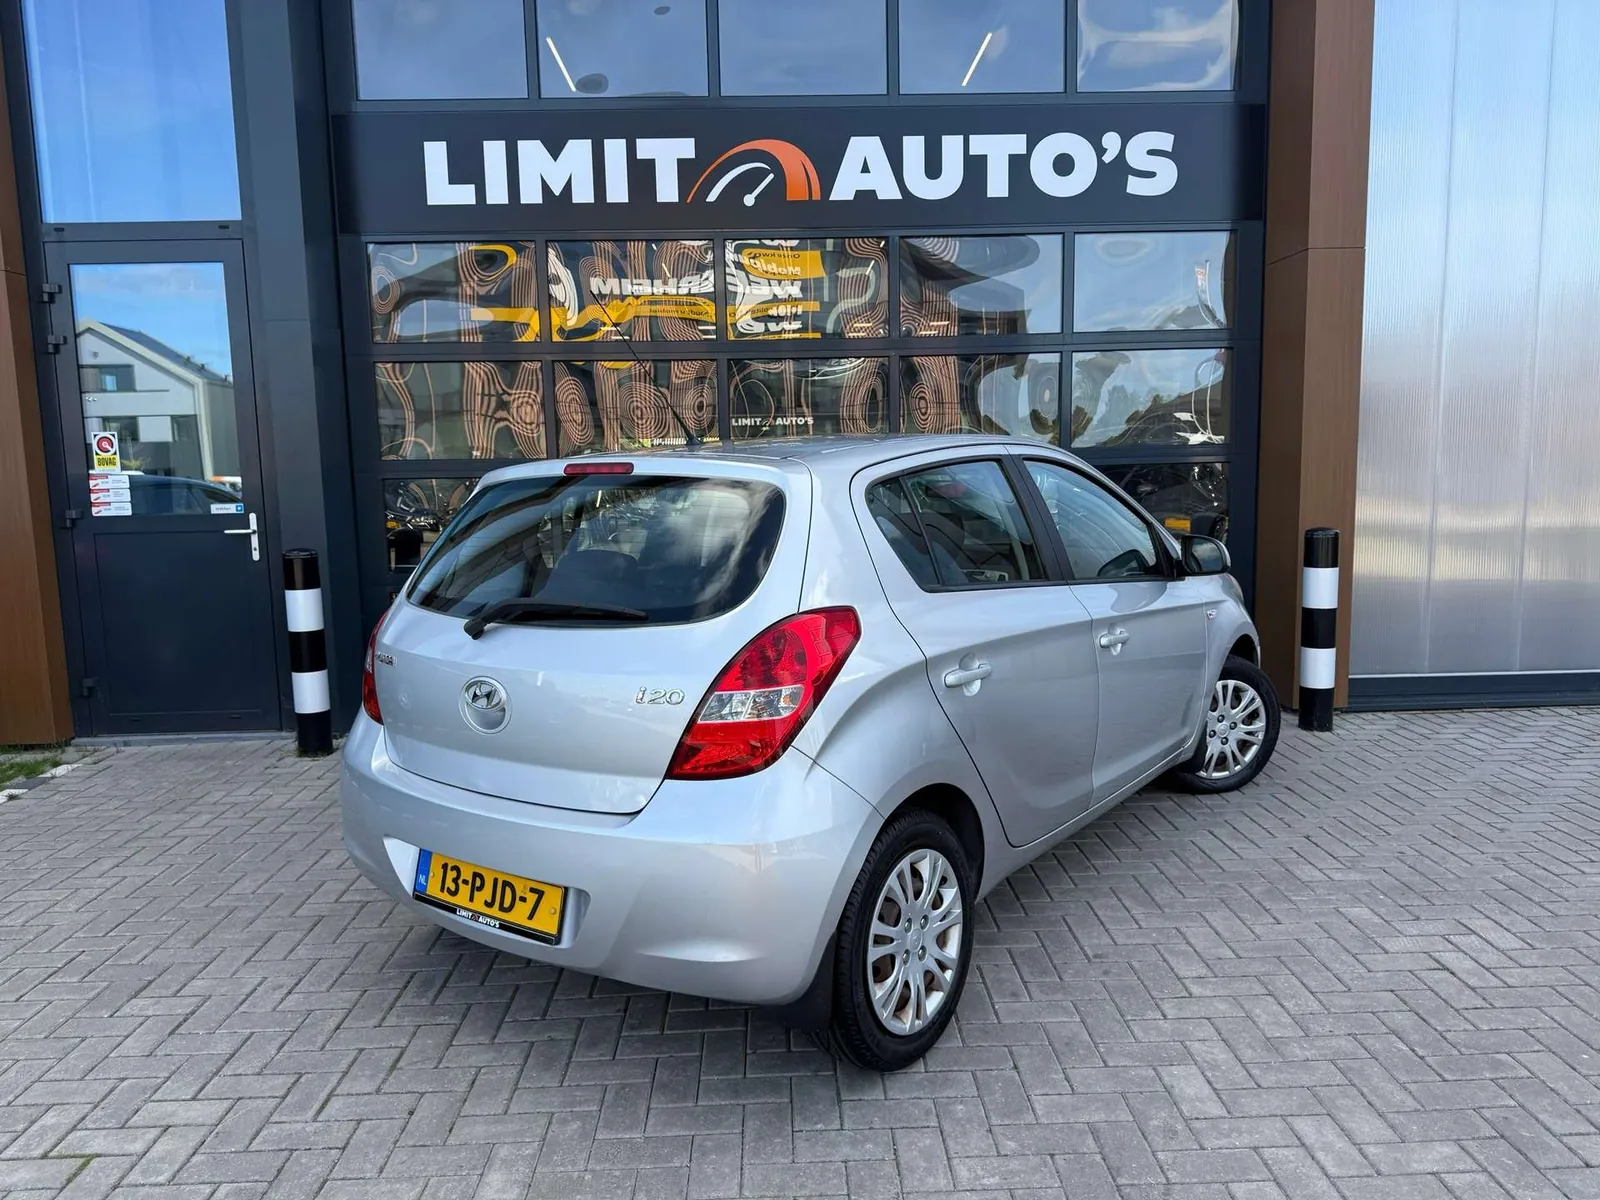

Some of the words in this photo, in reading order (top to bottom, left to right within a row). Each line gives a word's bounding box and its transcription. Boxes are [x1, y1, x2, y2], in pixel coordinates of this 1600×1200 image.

[423, 138, 696, 206] LIMIT
[829, 131, 1179, 202] AUTO'S
[731, 417, 762, 427] LIMIT
[775, 416, 814, 426] AUTO'S
[97, 457, 117, 467] BOVAG
[418, 873, 427, 886] NL
[440, 862, 545, 921] 13-PJD-7
[456, 907, 473, 919] LIMIT
[478, 915, 500, 928] AUTO'S
